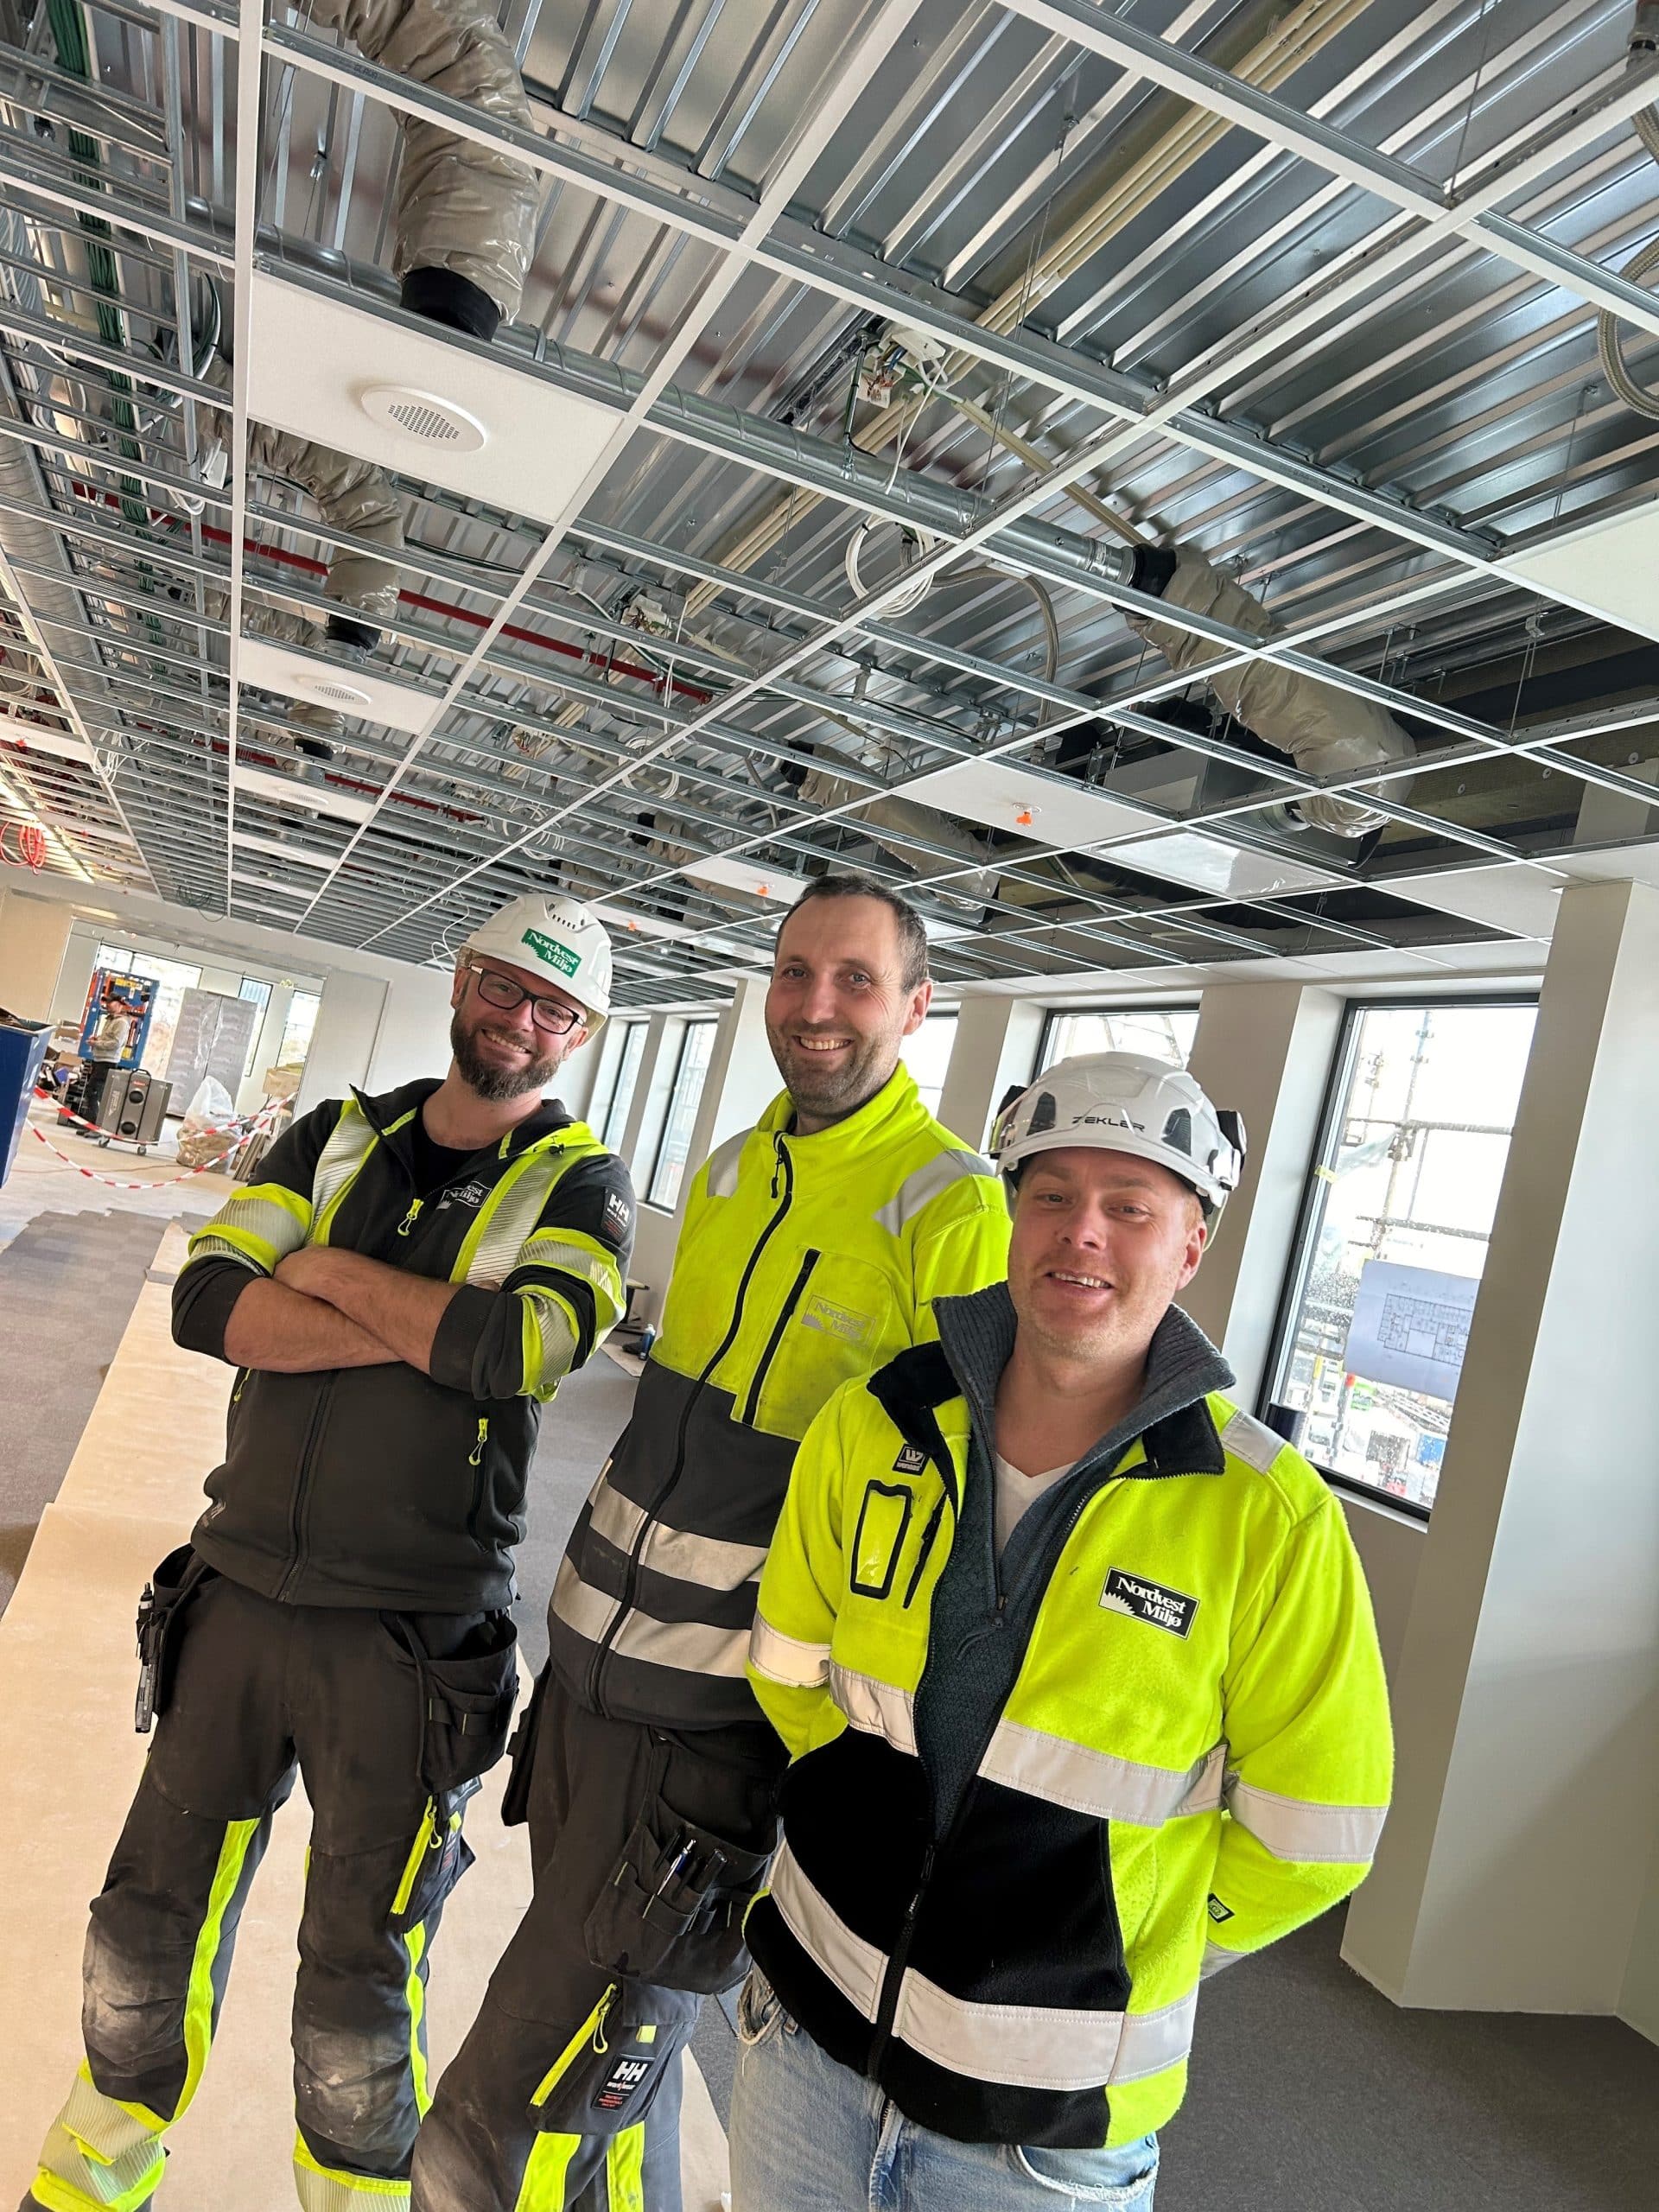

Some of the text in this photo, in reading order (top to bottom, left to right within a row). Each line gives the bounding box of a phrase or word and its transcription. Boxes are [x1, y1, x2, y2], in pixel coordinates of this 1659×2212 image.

[528, 932, 579, 965] Nordvest
[1071, 1116, 1145, 1133] ZEKLER
[1116, 1576, 1186, 1614] Nordvest
[1141, 1600, 1183, 1627] Miljø
[612, 2061, 648, 2082] HH
